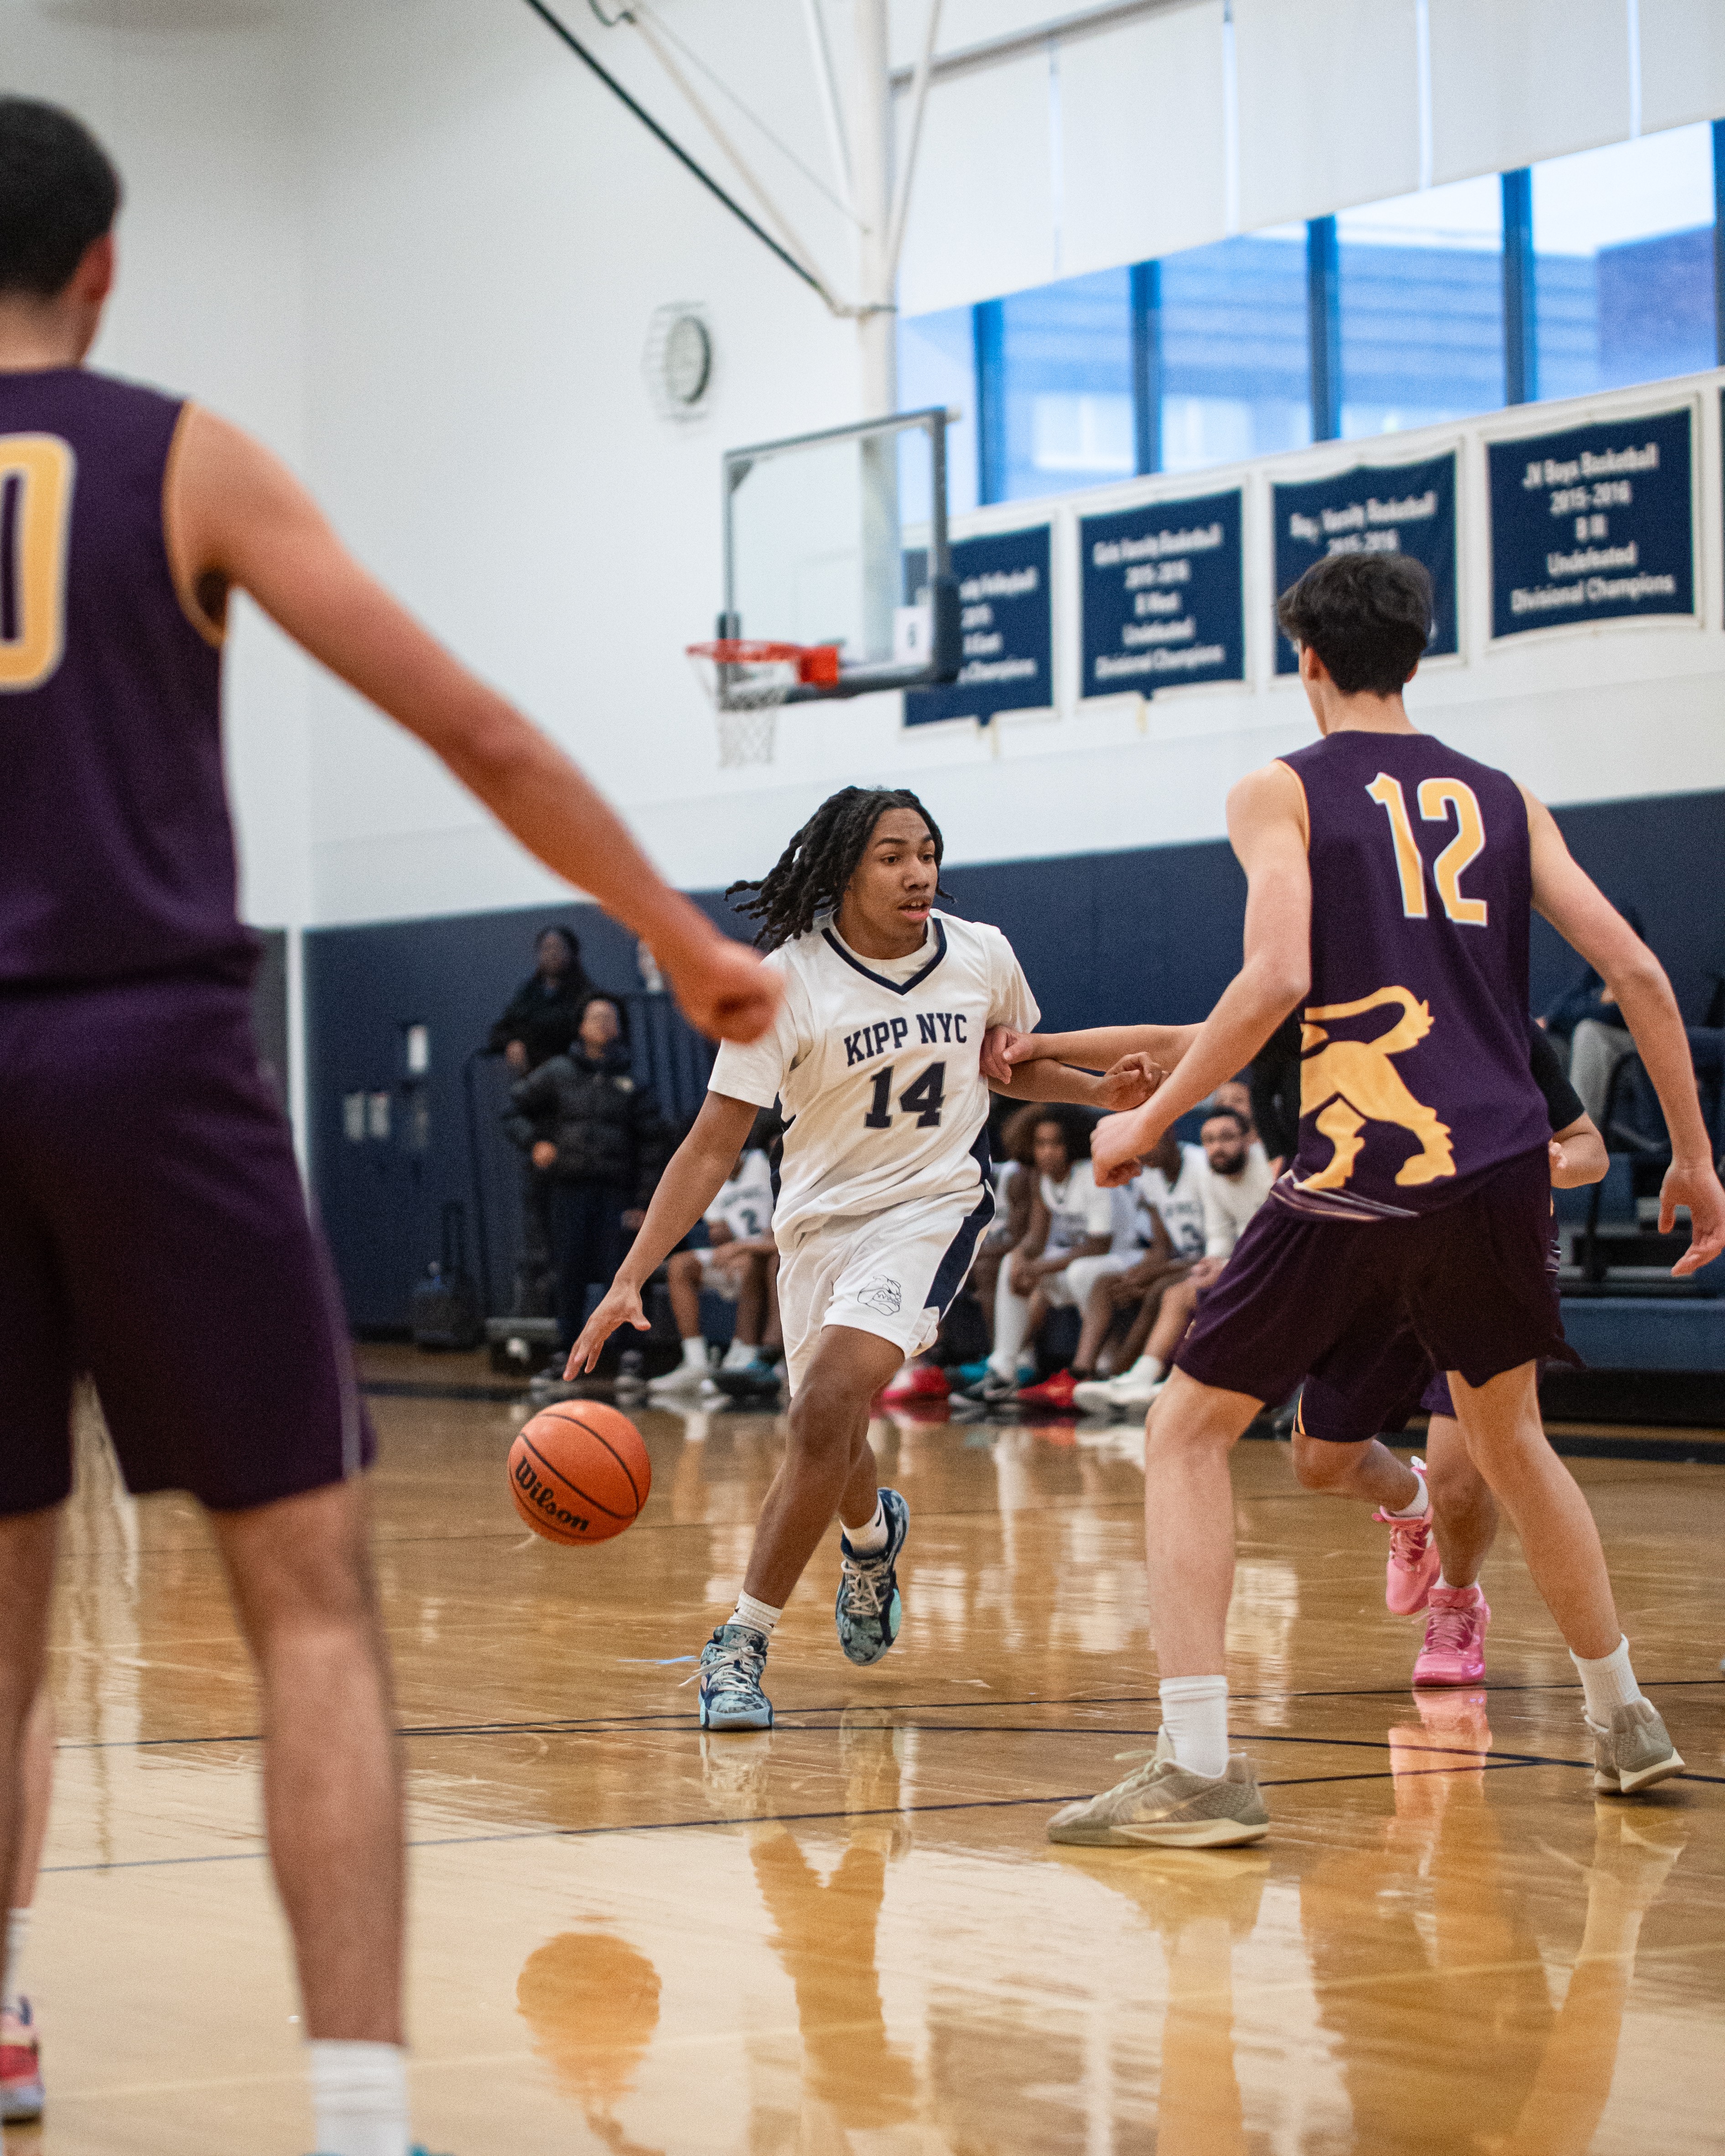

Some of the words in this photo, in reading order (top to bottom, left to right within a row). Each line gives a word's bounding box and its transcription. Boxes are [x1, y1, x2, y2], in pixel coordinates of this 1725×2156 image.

[1545, 459, 1580, 485] Boys
[1580, 442, 1659, 479] Basketball
[1323, 504, 1364, 533] Varsity
[1367, 490, 1436, 523] Basketball
[1159, 523, 1223, 554] Basketball
[1548, 542, 1637, 577] Undefeated
[1511, 578, 1585, 613] Divisional
[1587, 573, 1674, 602] Champions
[1365, 772, 1488, 927] 12
[843, 1016, 908, 1067] KIPP
[916, 1013, 967, 1045] NYC
[863, 1061, 947, 1130] 14
[515, 1455, 590, 1531] Wilson
